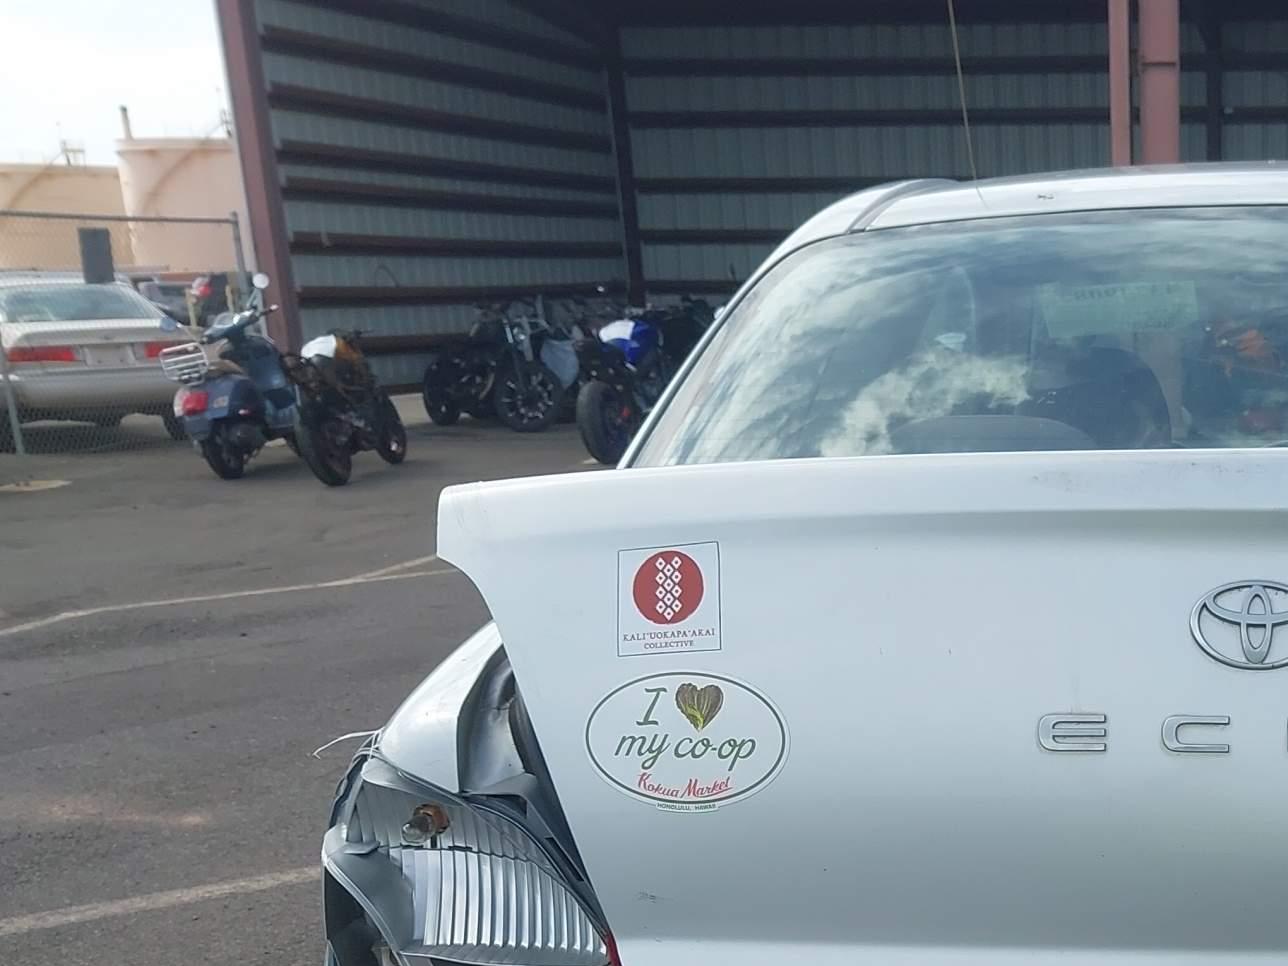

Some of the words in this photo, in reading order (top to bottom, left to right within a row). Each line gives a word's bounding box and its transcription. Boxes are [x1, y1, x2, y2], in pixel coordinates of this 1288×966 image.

[643, 640, 694, 649] COLLECTIVE
[636, 687, 667, 726] I
[614, 734, 670, 770] my
[673, 737, 756, 772] co-op
[637, 772, 680, 797] Kokua
[680, 776, 733, 798] Market
